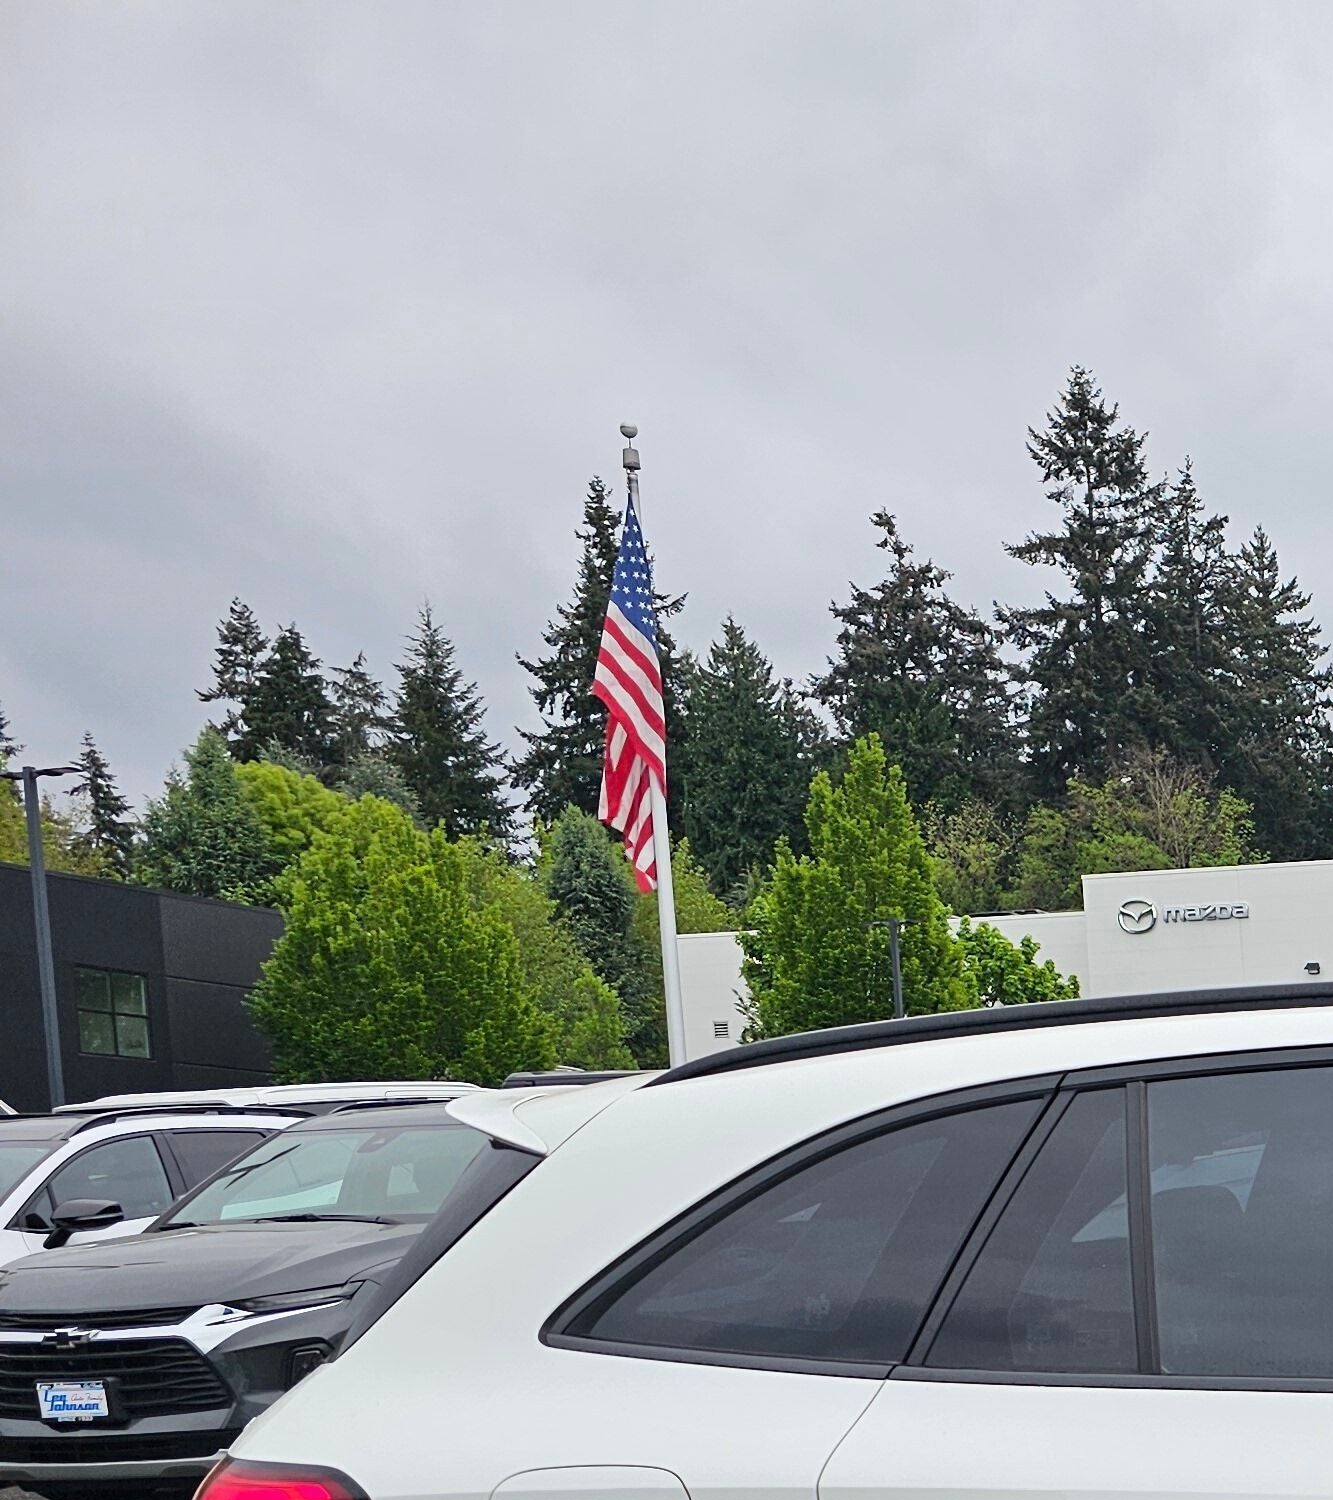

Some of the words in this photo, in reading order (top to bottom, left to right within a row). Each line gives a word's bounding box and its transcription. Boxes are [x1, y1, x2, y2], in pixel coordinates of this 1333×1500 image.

[1162, 902, 1250, 924] mazda
[44, 1389, 67, 1402] Lee
[48, 1398, 100, 1412] Johnson
